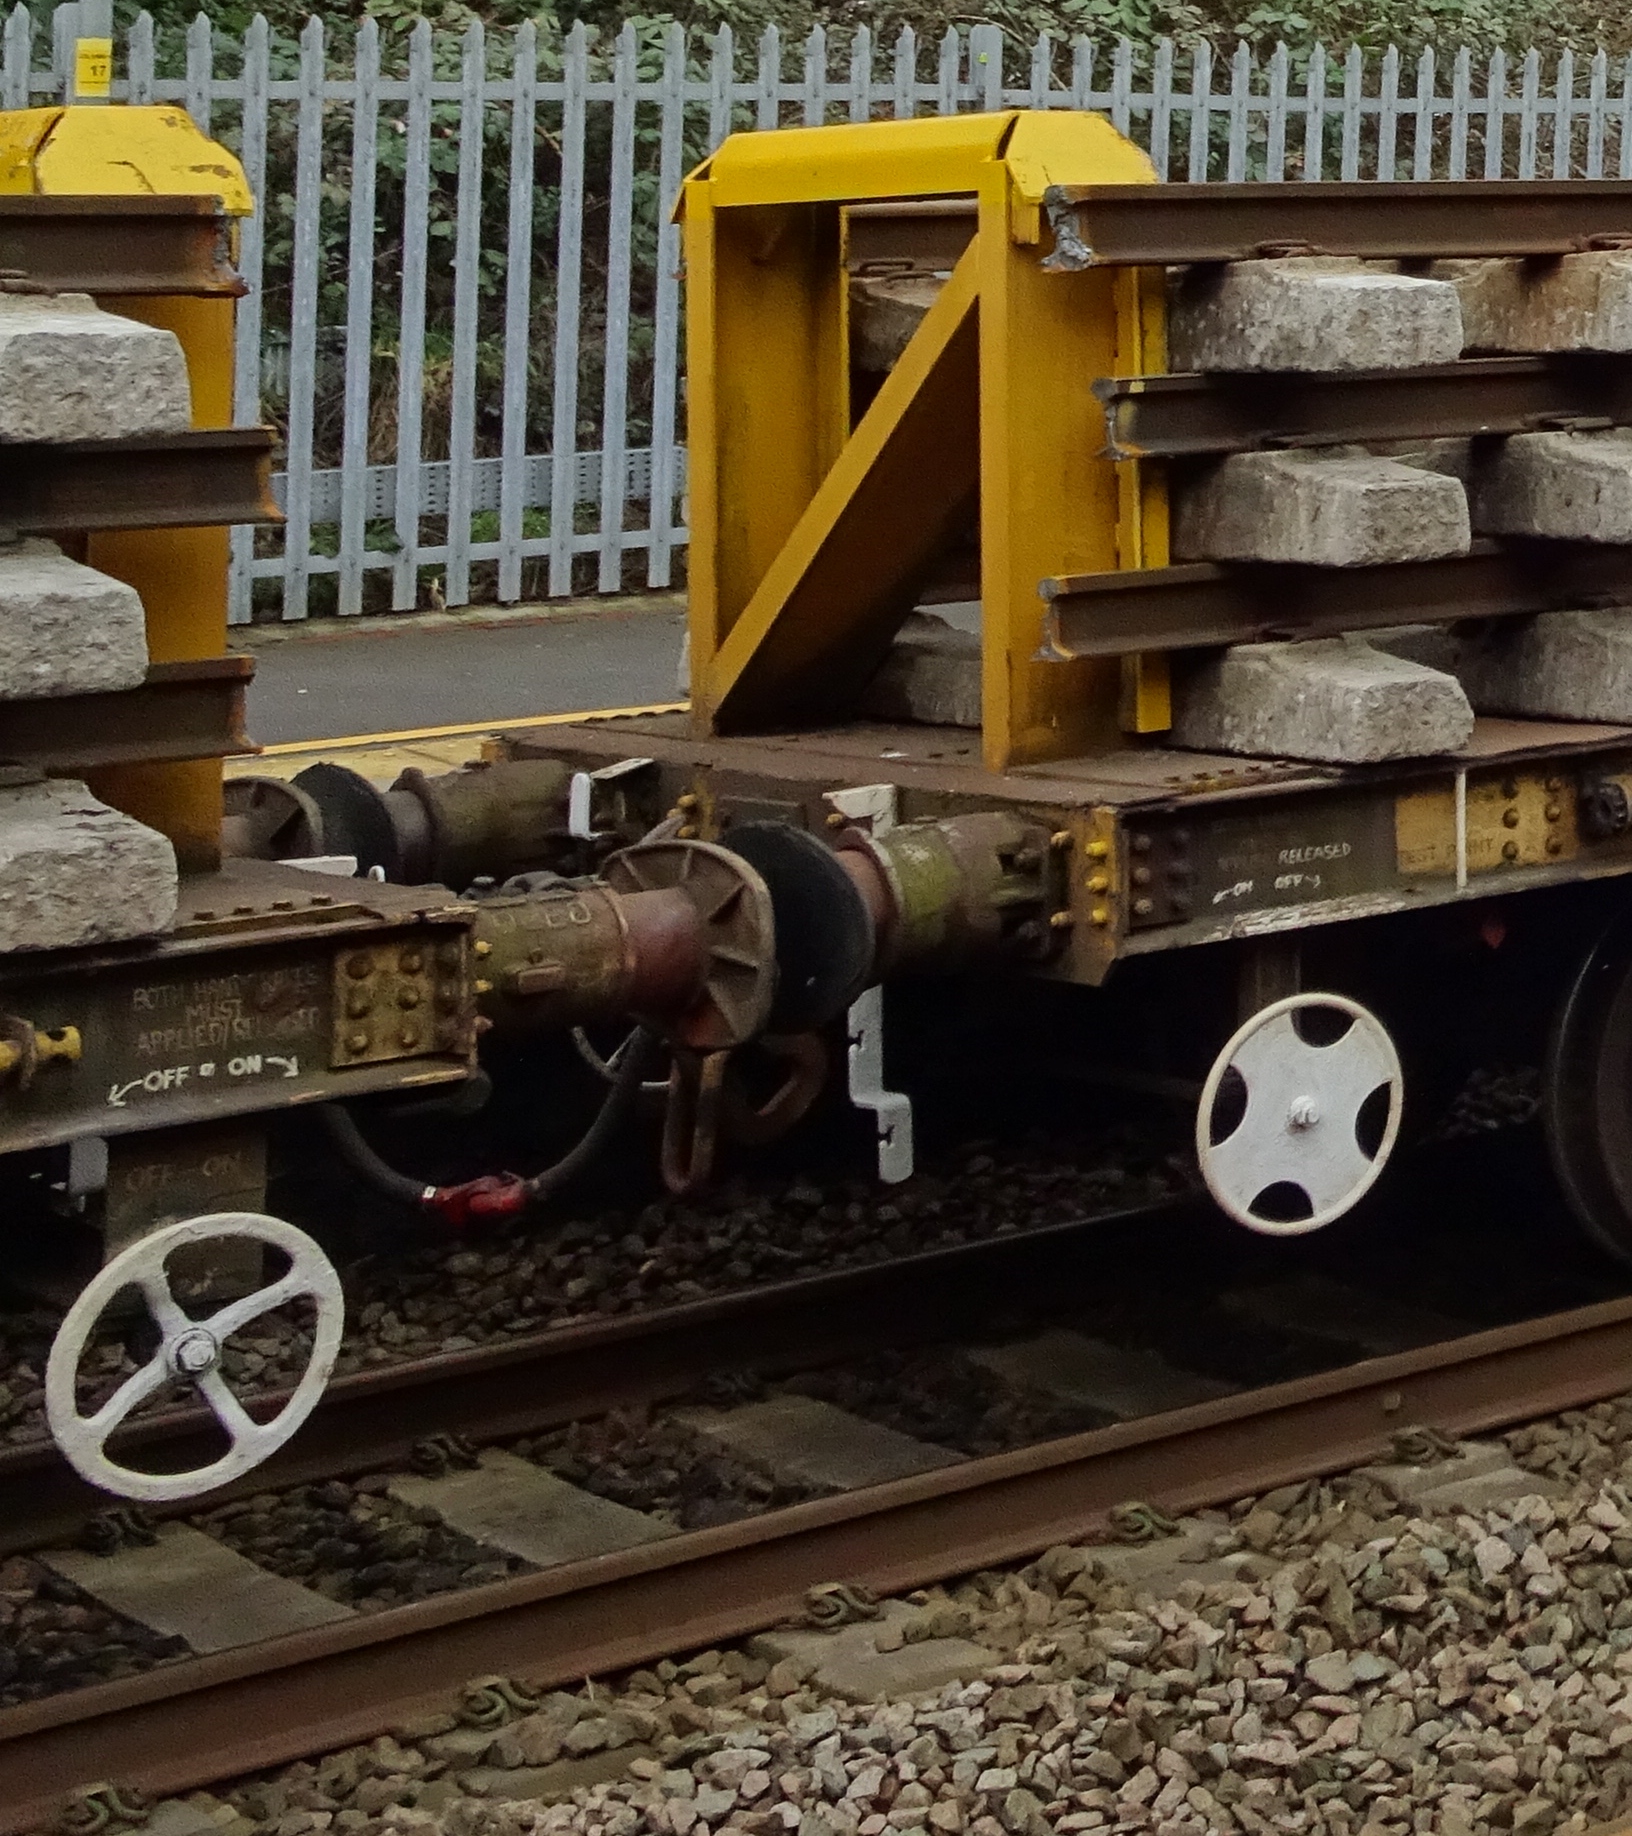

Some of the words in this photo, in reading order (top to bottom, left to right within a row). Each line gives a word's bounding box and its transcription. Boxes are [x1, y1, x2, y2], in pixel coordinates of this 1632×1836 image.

[90, 65, 107, 76] 17
[1279, 842, 1352, 865] RELEASED
[227, 1053, 264, 1076] ON
[143, 1065, 191, 1092] OFF
